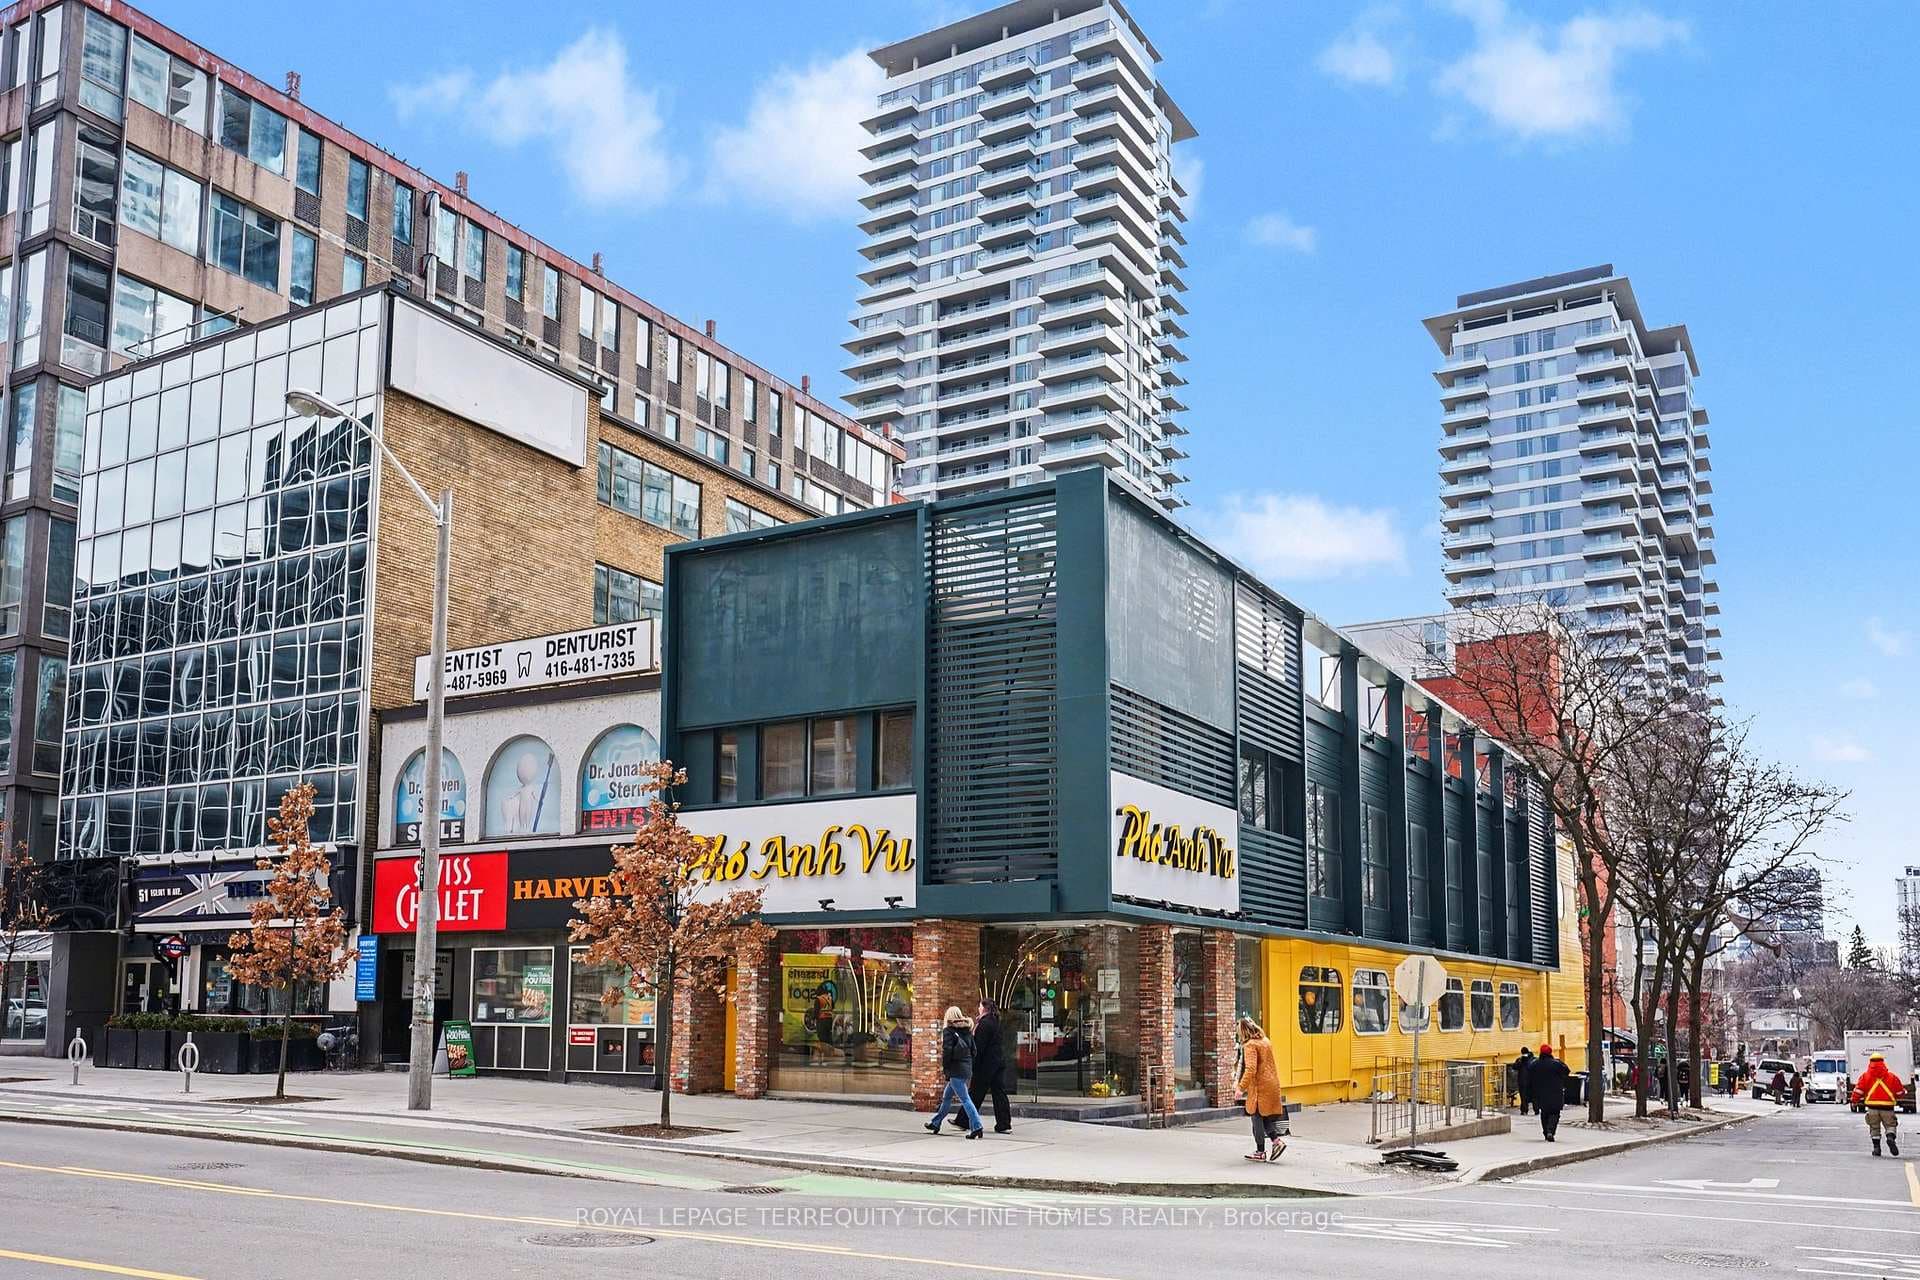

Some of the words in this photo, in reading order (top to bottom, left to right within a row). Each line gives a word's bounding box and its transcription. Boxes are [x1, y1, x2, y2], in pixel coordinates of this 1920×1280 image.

[546, 627, 638, 659] DENTURIST
[444, 648, 503, 673] ENTIST
[545, 651, 636, 679] 416-481-7335
[426, 669, 507, 692] -487-5969
[589, 764, 605, 780] Dr.
[408, 781, 422, 795] Dr.
[584, 808, 646, 830] ENTS
[407, 821, 461, 842] SLE
[752, 825, 845, 879] Anh
[846, 823, 916, 873] Vu
[1159, 825, 1209, 873] Anh
[1204, 829, 1235, 880] Vu
[138, 888, 149, 903] 51
[396, 884, 485, 929] CHLET
